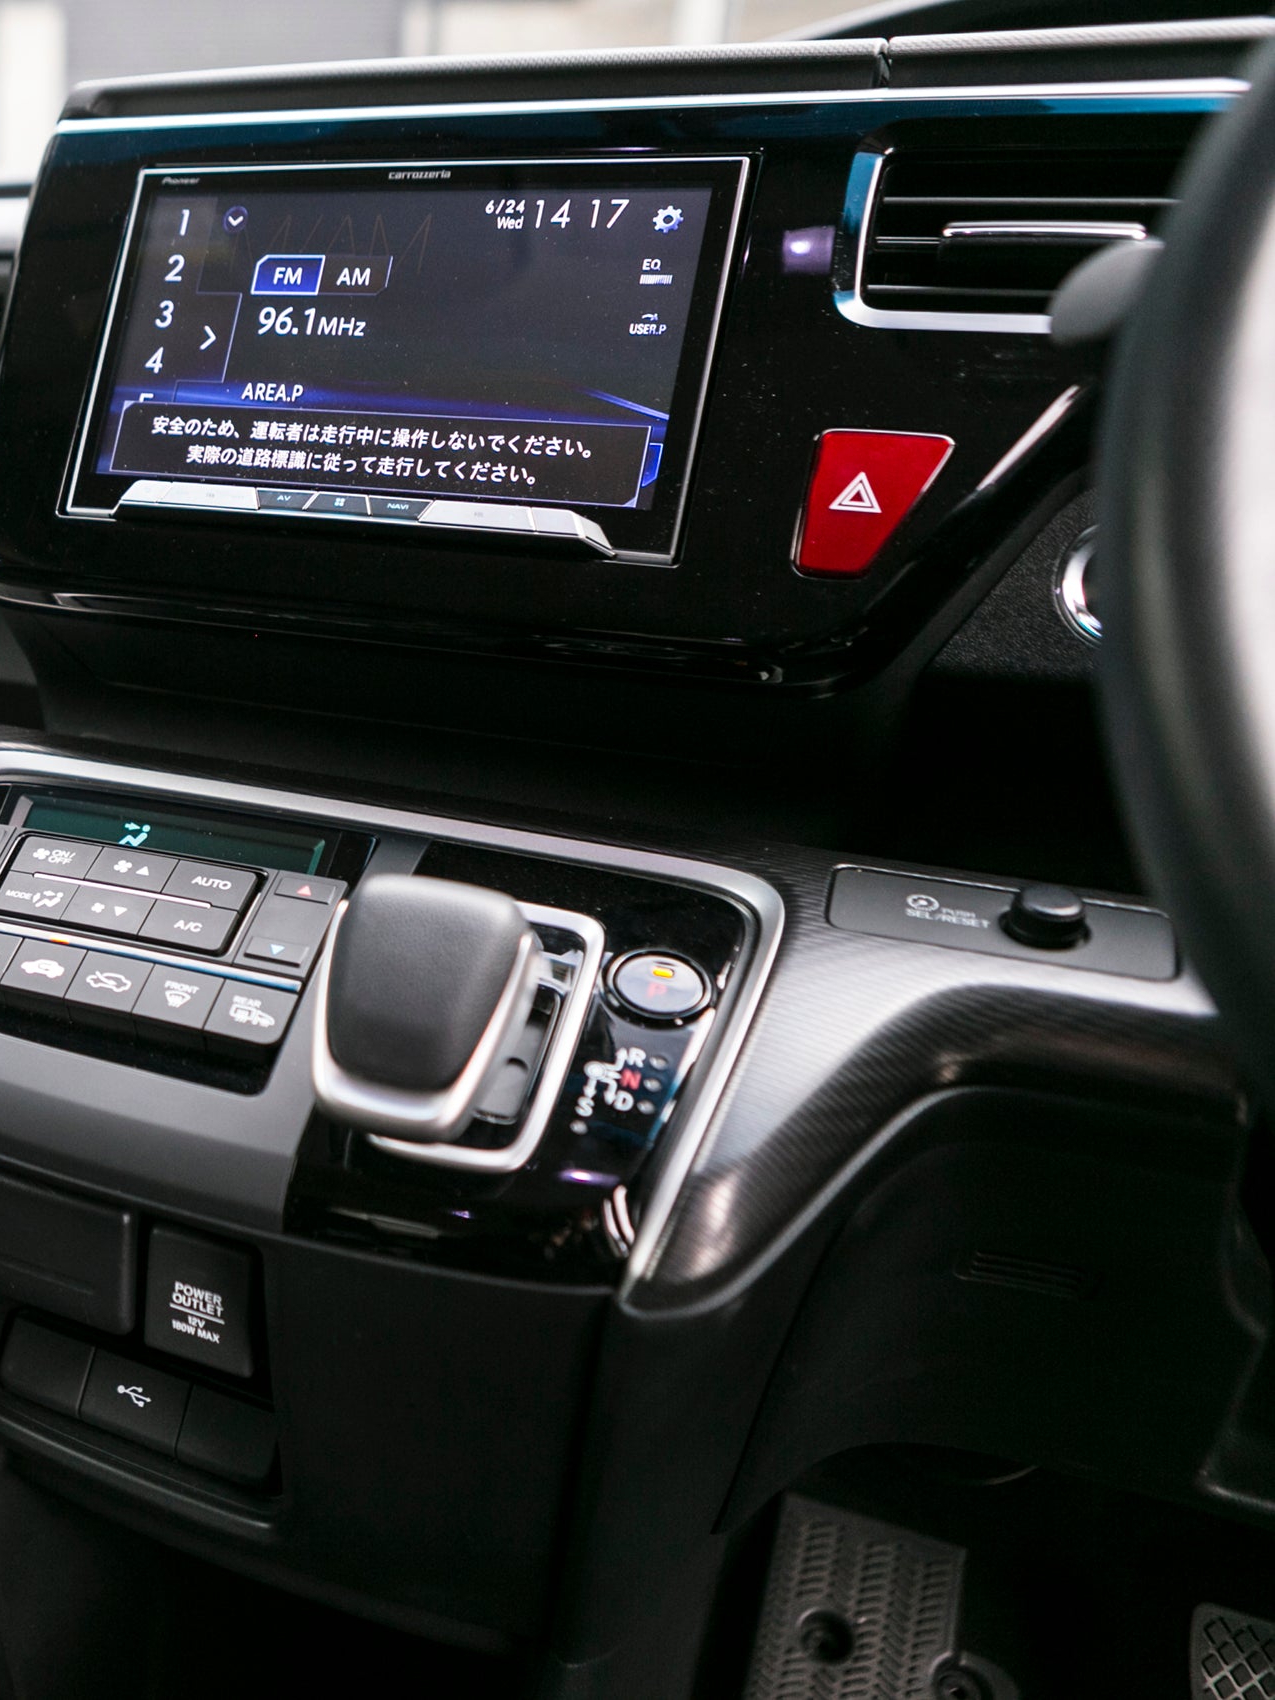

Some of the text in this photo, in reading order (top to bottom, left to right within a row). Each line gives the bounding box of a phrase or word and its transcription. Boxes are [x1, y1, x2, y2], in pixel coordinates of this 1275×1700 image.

[388, 169, 452, 180] carrozzeria
[485, 199, 526, 216] 6/24
[179, 208, 191, 237] 1
[496, 216, 524, 230] Wed
[164, 254, 186, 283] 2
[641, 258, 663, 272] EQ
[272, 266, 304, 286] FM
[335, 267, 372, 287] AM
[154, 299, 175, 329] 3
[629, 322, 668, 336] USER.P
[145, 346, 165, 374] 4
[241, 382, 305, 403] AREA.P
[276, 494, 292, 503] AV
[386, 502, 410, 511] NAVI
[47, 855, 74, 865] OFF
[191, 875, 233, 891] AUTO
[5, 889, 33, 901] MODE
[173, 918, 204, 934] A/C
[905, 907, 991, 929] SEL/RESET
[164, 980, 200, 995] FRONT
[647, 982, 668, 998] P
[232, 994, 263, 1009] REAR
[626, 1046, 647, 1068] R
[620, 1068, 642, 1091] N
[574, 1096, 595, 1117] S
[612, 1089, 635, 1112] D
[174, 1281, 223, 1306] POWER
[171, 1292, 224, 1318] OUTLET
[187, 1315, 206, 1329] 12V
[171, 1319, 221, 1345] 180W MAX
